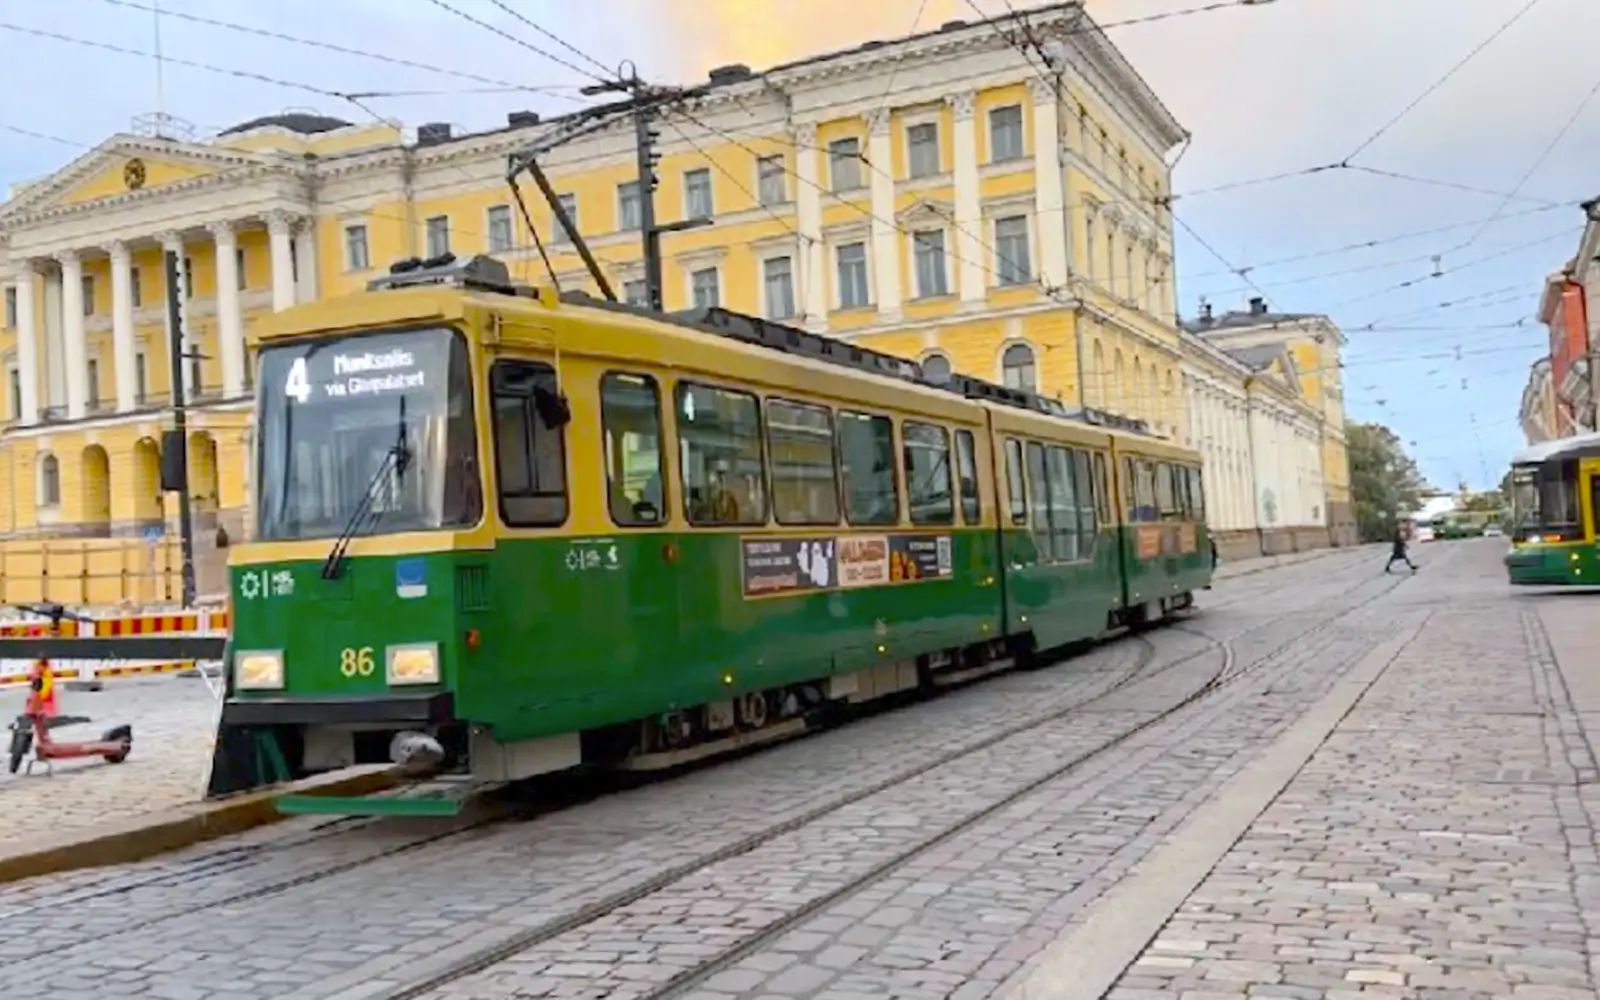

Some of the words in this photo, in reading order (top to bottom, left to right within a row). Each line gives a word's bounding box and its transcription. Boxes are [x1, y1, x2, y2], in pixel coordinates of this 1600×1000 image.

[285, 357, 311, 402] 4
[325, 382, 347, 396] via
[340, 647, 375, 677] 86
